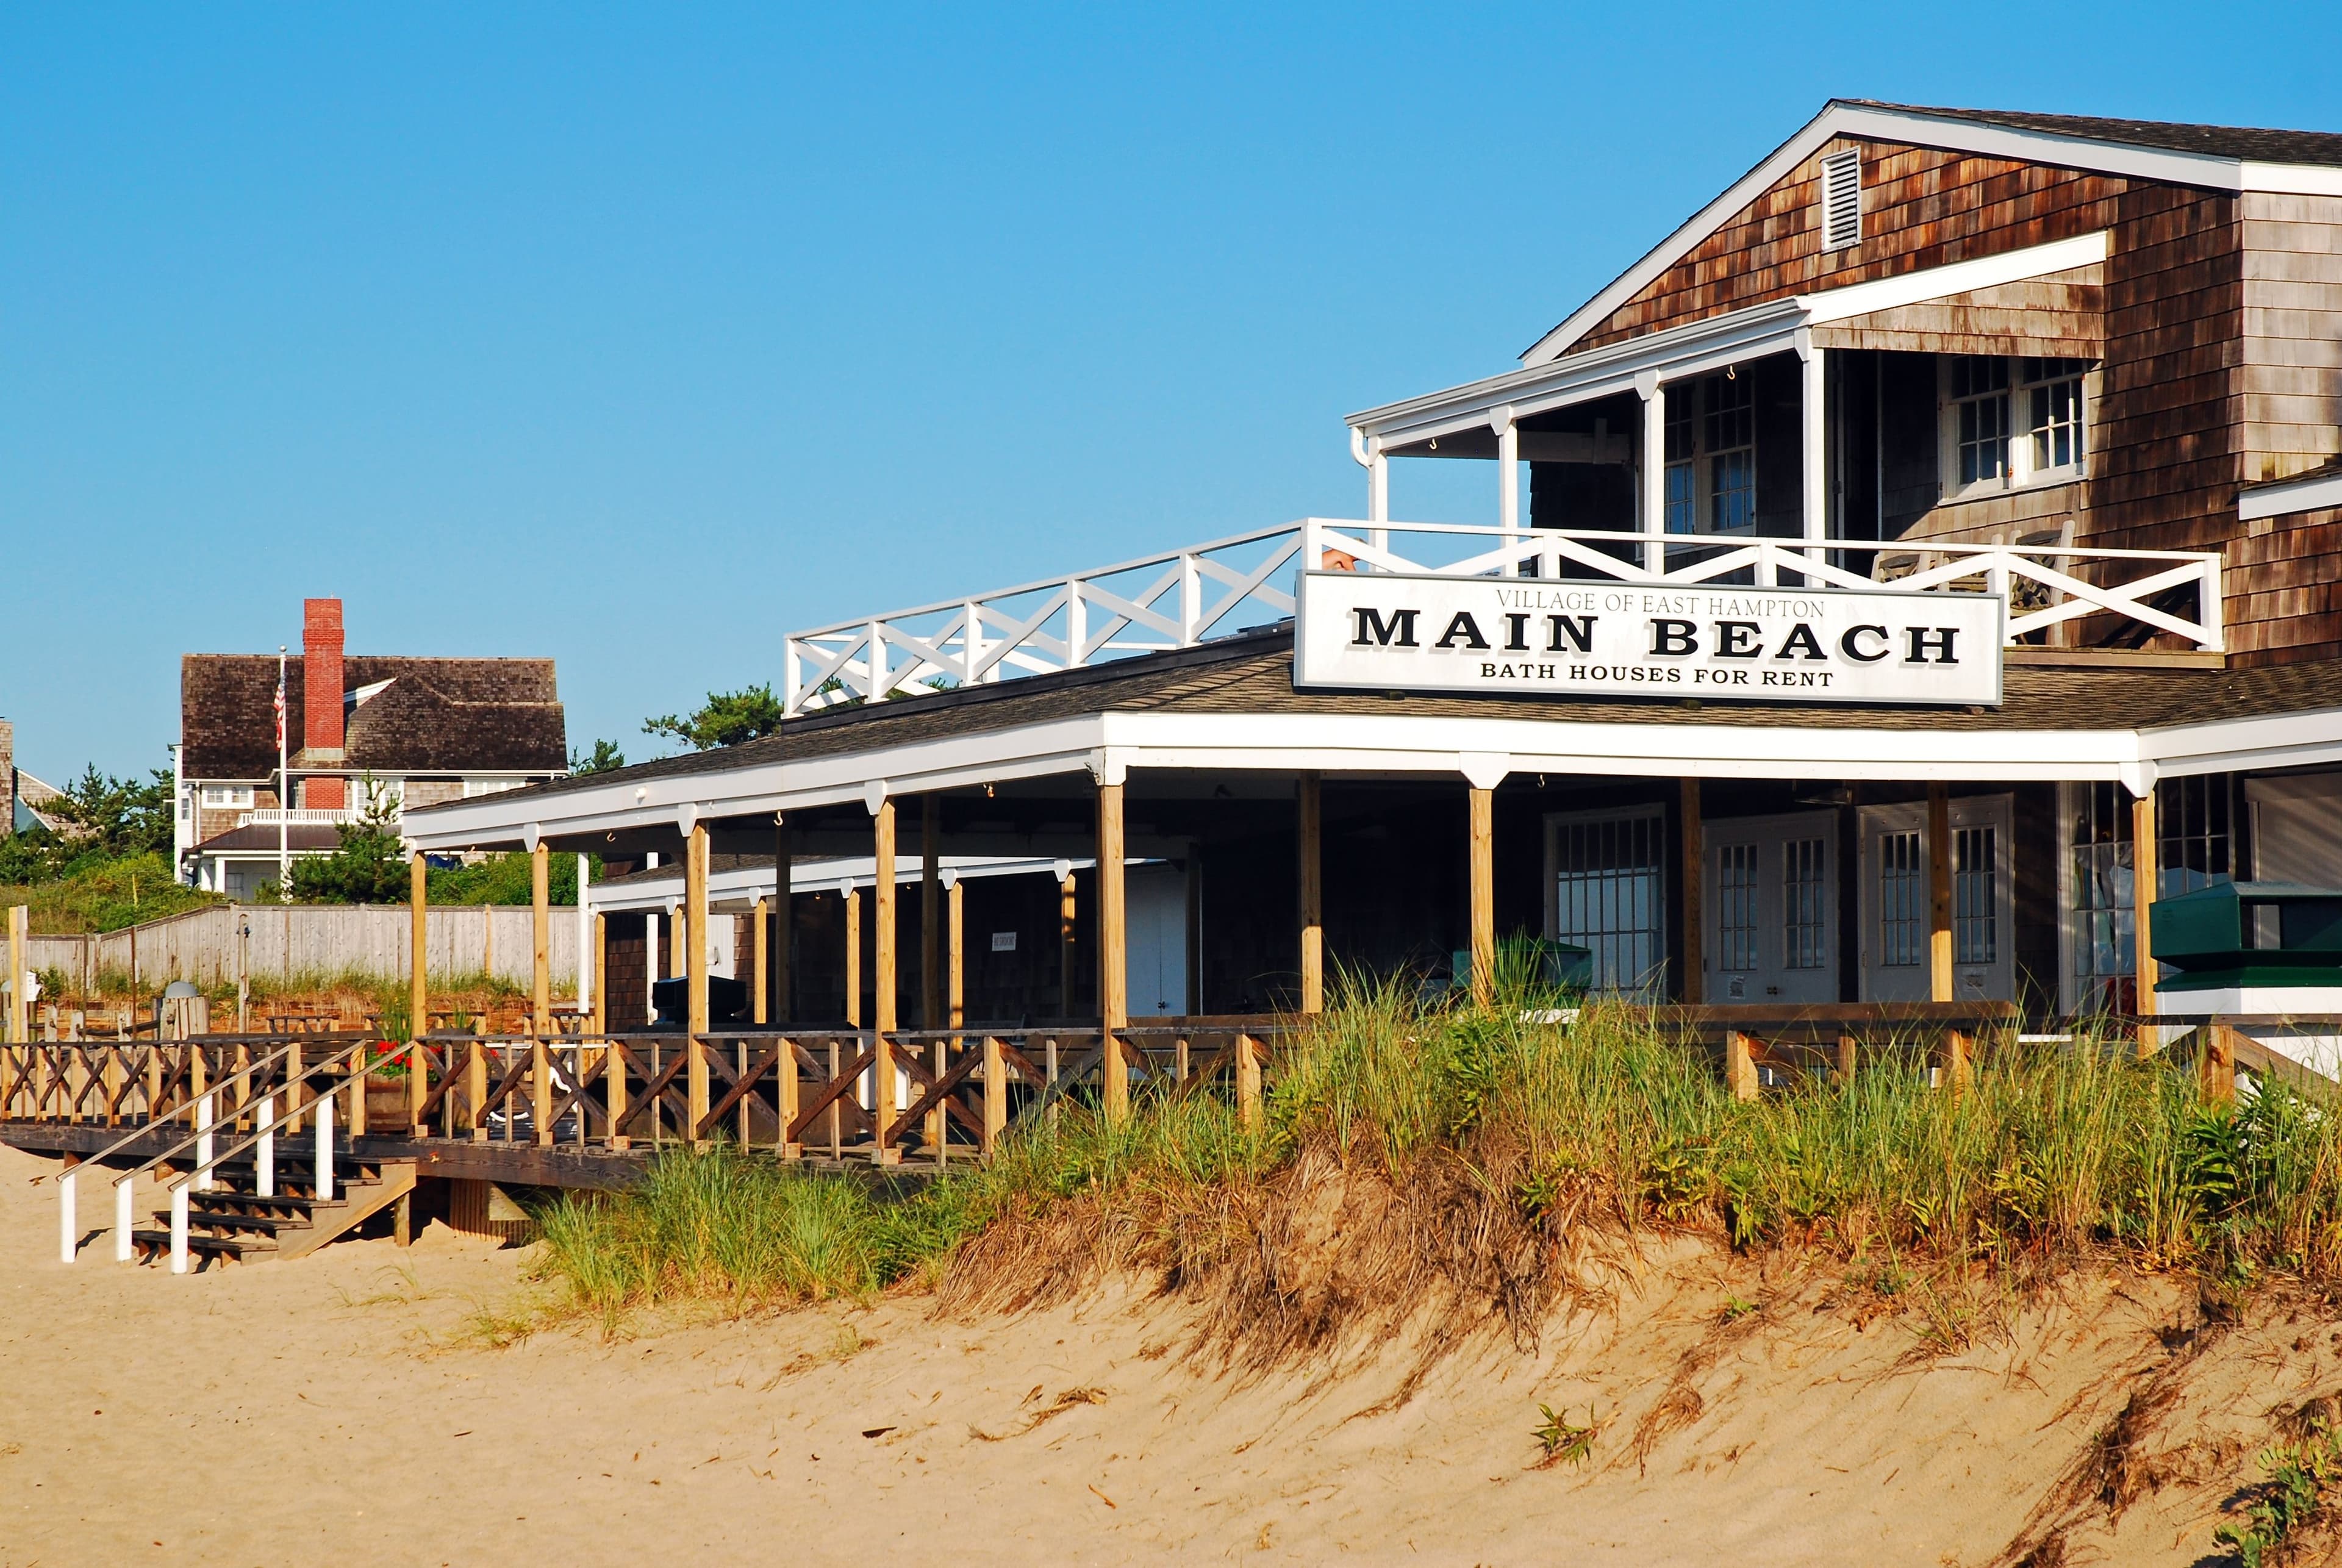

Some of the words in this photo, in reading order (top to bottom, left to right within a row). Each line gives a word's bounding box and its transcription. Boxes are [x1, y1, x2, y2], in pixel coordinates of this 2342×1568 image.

[1496, 589, 1596, 610] VILLAGE
[1605, 593, 1635, 612] OF
[1642, 595, 1700, 615] EAST
[1709, 598, 1825, 618] HAMPTON
[1351, 607, 1599, 653] MAIN
[1649, 618, 1960, 664] BEACH
[1481, 662, 1556, 679] BATH
[1569, 665, 1681, 682] HOUSES
[1694, 668, 1750, 684] FOR
[1761, 671, 1834, 687] RENT
